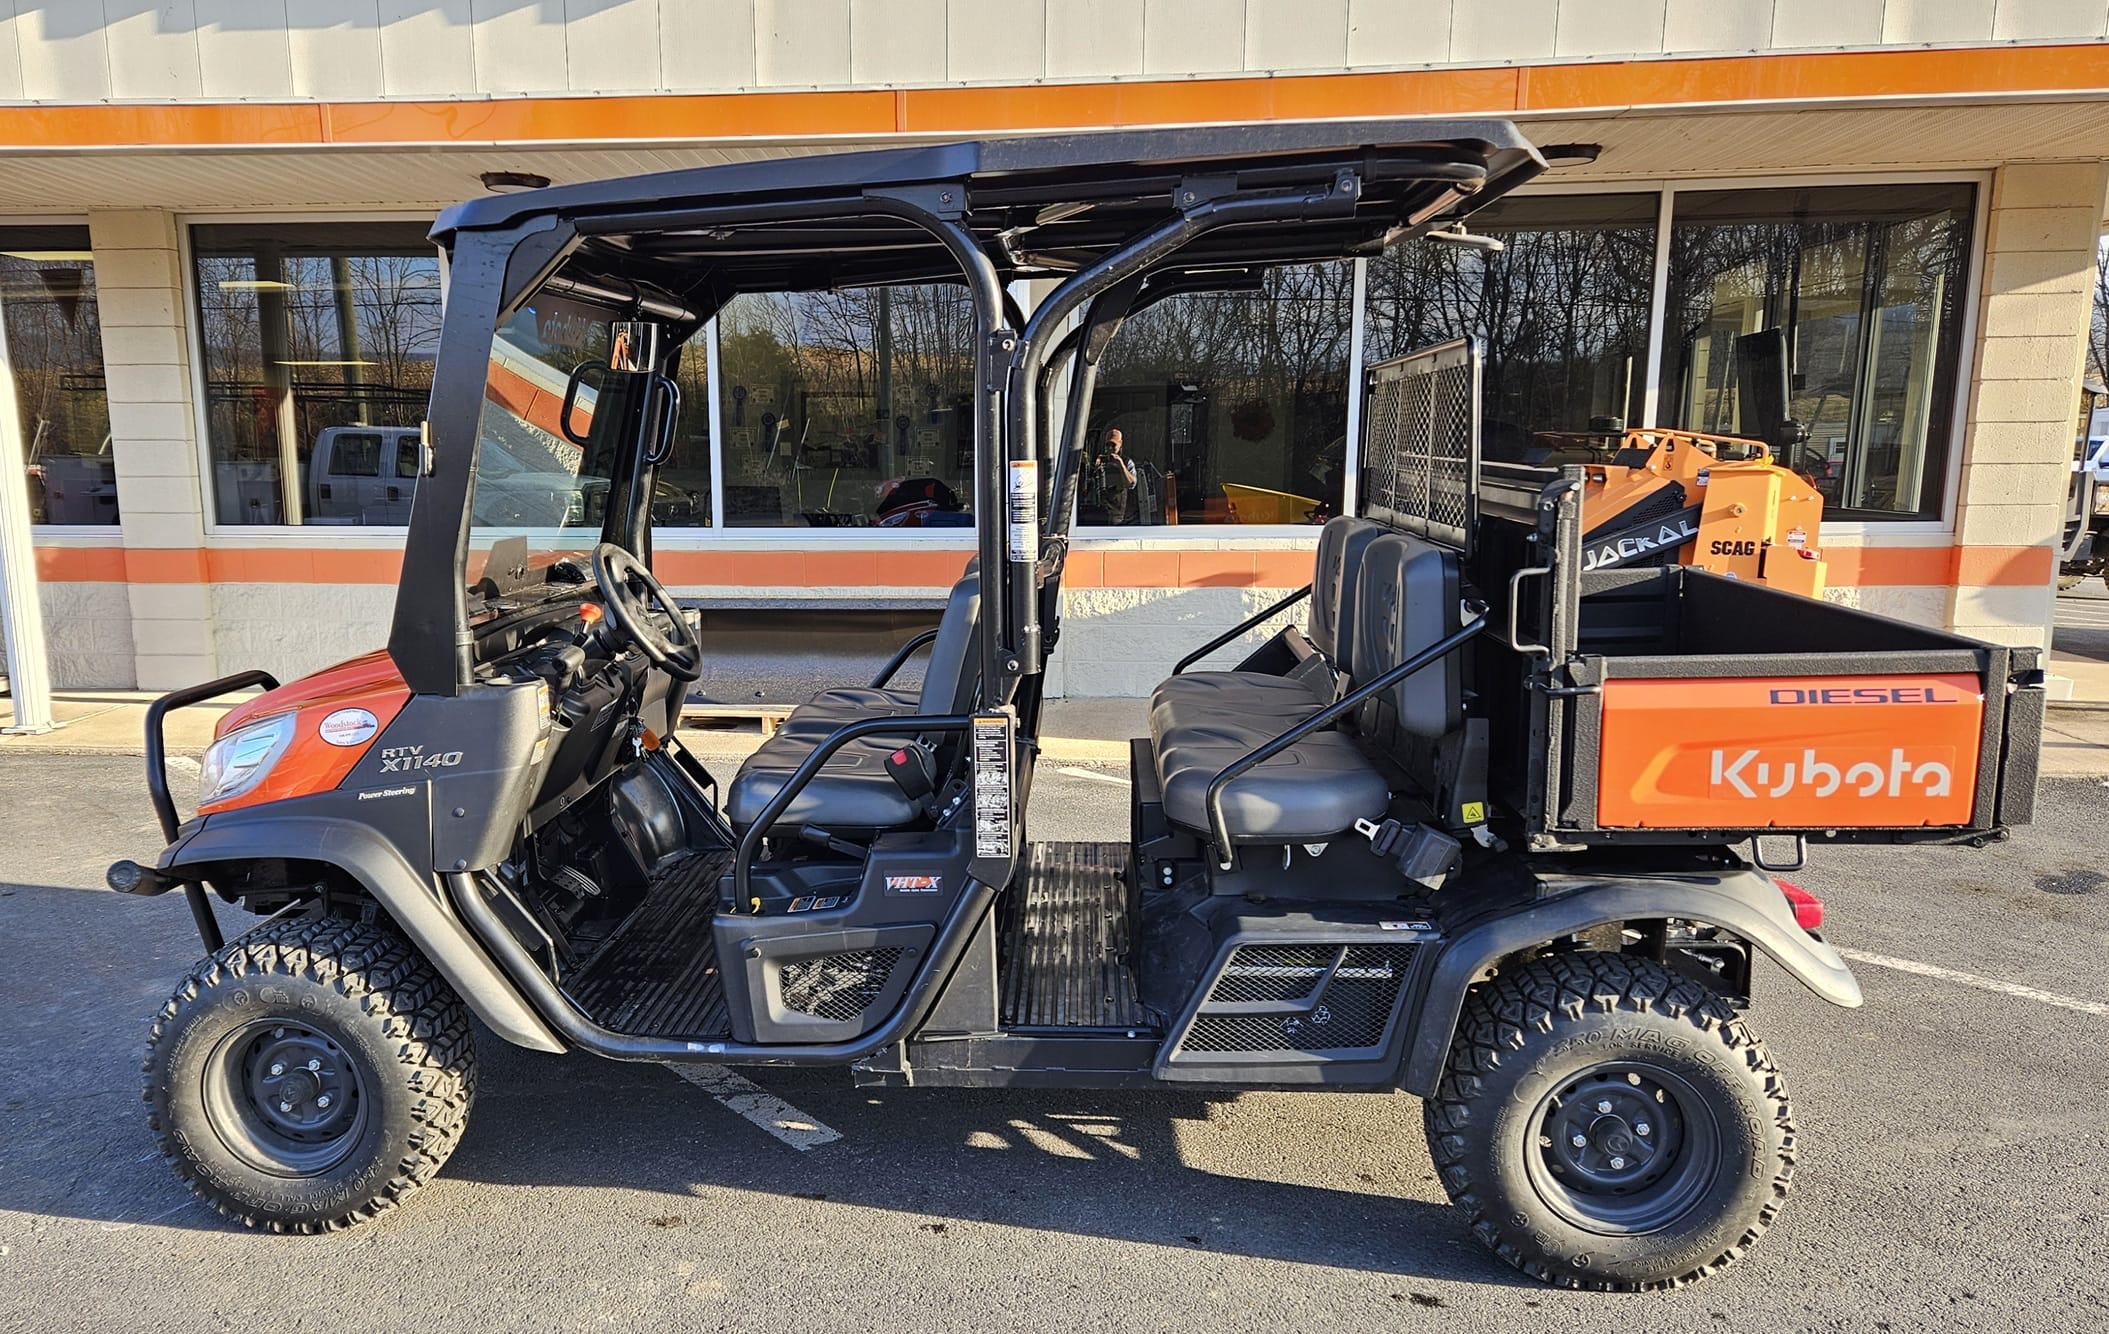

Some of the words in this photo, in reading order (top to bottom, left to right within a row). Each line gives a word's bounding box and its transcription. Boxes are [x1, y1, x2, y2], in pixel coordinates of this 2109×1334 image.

[1582, 519, 1699, 572] JACKAL
[1710, 540, 1756, 556] SCAG
[1769, 687, 1958, 705] DIESEL
[325, 718, 361, 729] Woodstock
[381, 745, 424, 759] RTV
[380, 751, 464, 773] X1140
[1710, 748, 1951, 798] Kubota
[358, 791, 382, 801] Power
[382, 786, 416, 798] Steering
[1629, 1041, 1681, 1059] SERVICE
[1551, 1030, 1602, 1057] 350
[1609, 1027, 1691, 1049] MAG
[1694, 1050, 1746, 1092] OFF
[1737, 1097, 1766, 1180] ROAD
[290, 1189, 350, 1214] MAG
